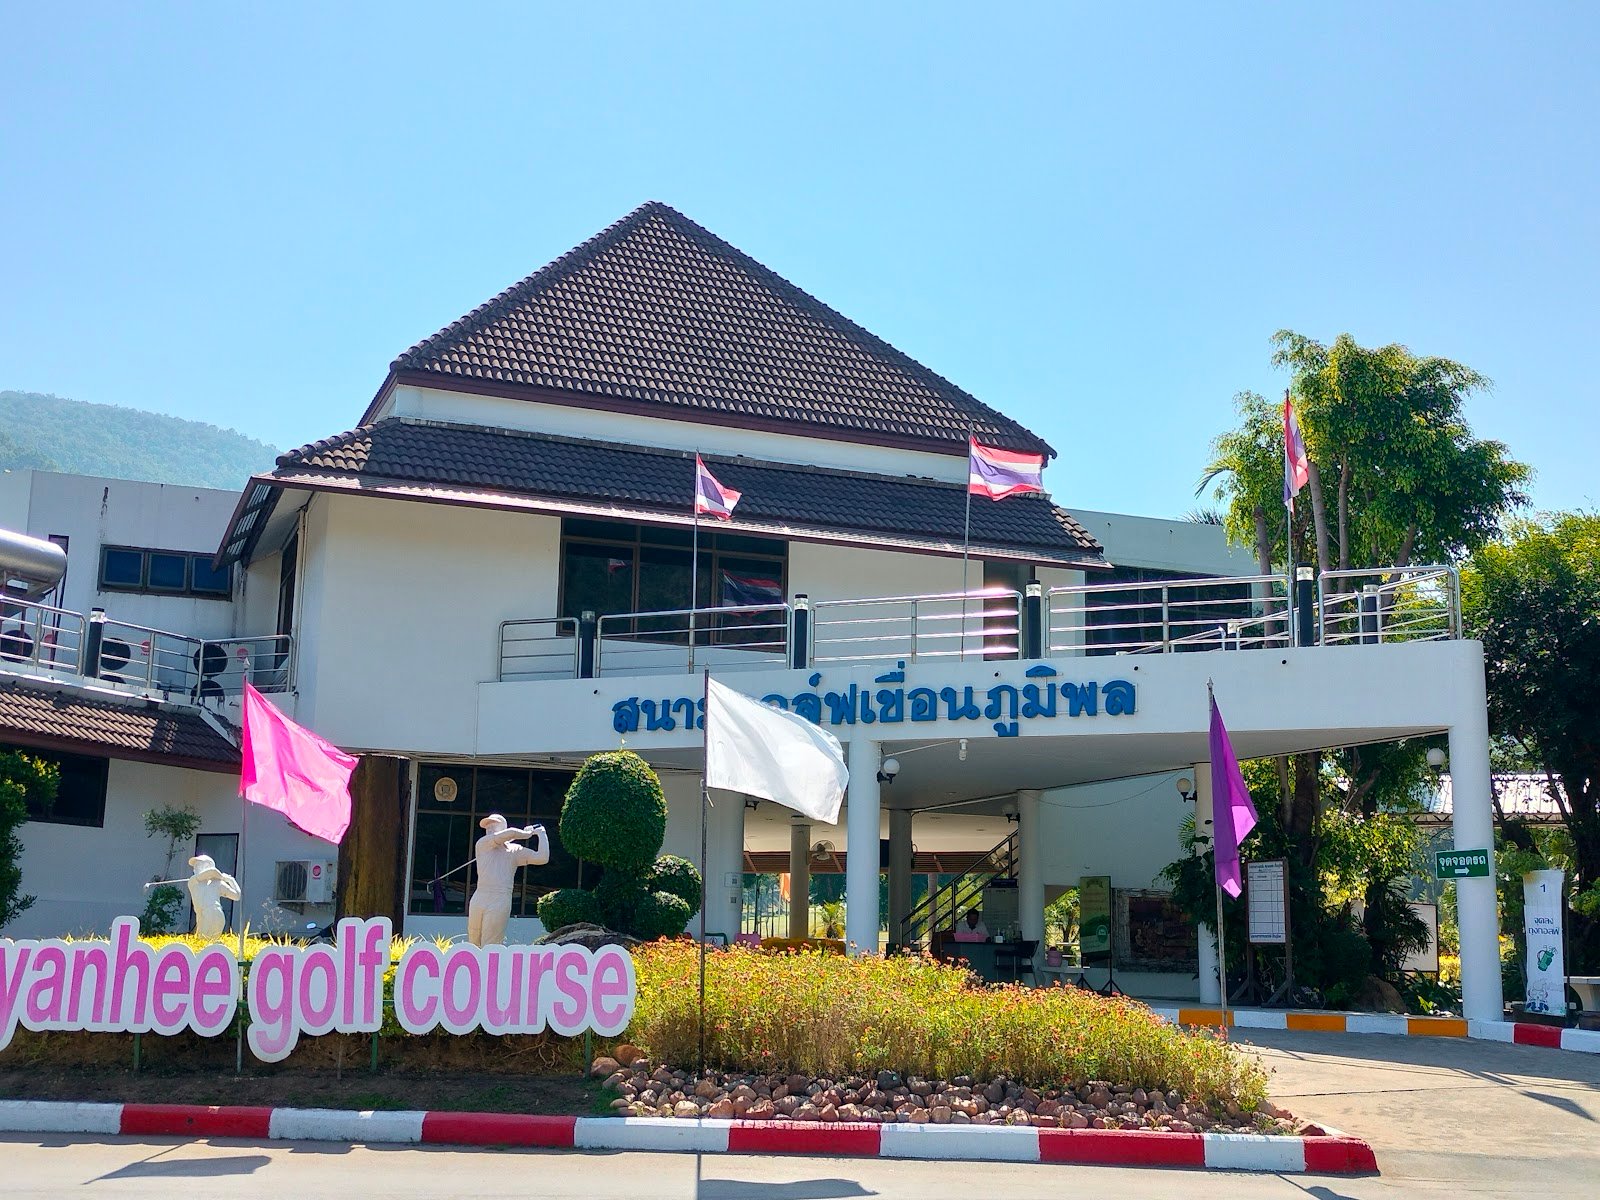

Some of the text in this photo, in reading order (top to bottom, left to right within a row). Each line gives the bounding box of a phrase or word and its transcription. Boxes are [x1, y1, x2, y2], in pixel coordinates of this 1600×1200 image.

[1438, 855, 1486, 871] จุดจอดรถ
[1540, 884, 1546, 893] 1
[0, 925, 629, 1054] yanhee golf course
